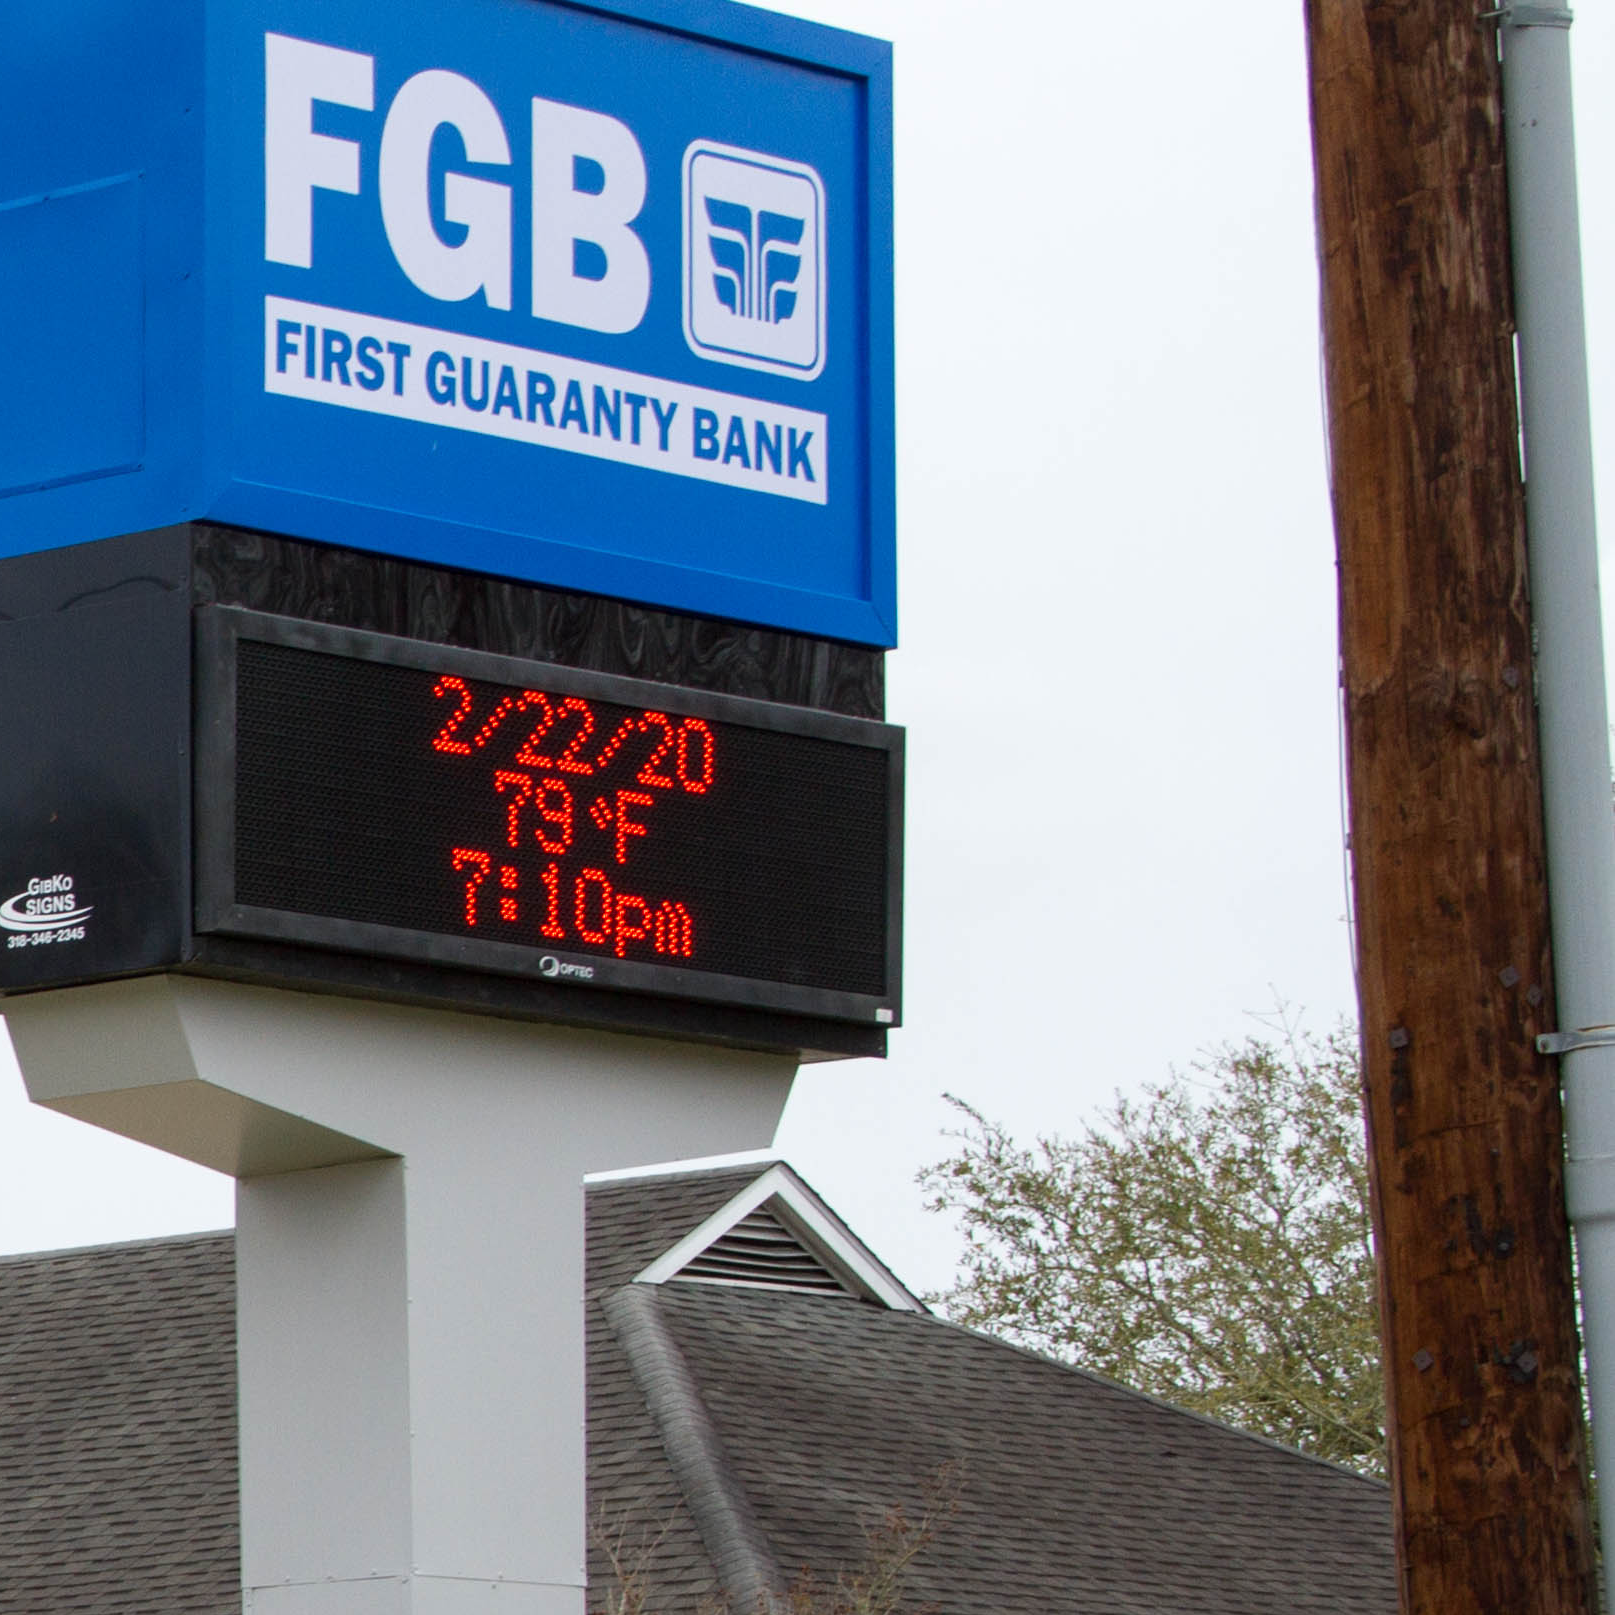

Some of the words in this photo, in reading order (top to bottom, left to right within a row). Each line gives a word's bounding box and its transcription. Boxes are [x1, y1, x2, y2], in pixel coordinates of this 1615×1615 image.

[265, 31, 652, 334] FGB
[276, 318, 412, 397] FIRST
[424, 350, 679, 452] GUARANTY
[692, 406, 816, 483] BANK
[431, 675, 715, 794] 2/22/20
[6, 926, 86, 949] 318-346-2345
[25, 893, 76, 916] SIGNS
[451, 847, 693, 958] 7:10pm
[560, 962, 594, 979] OPTEC
